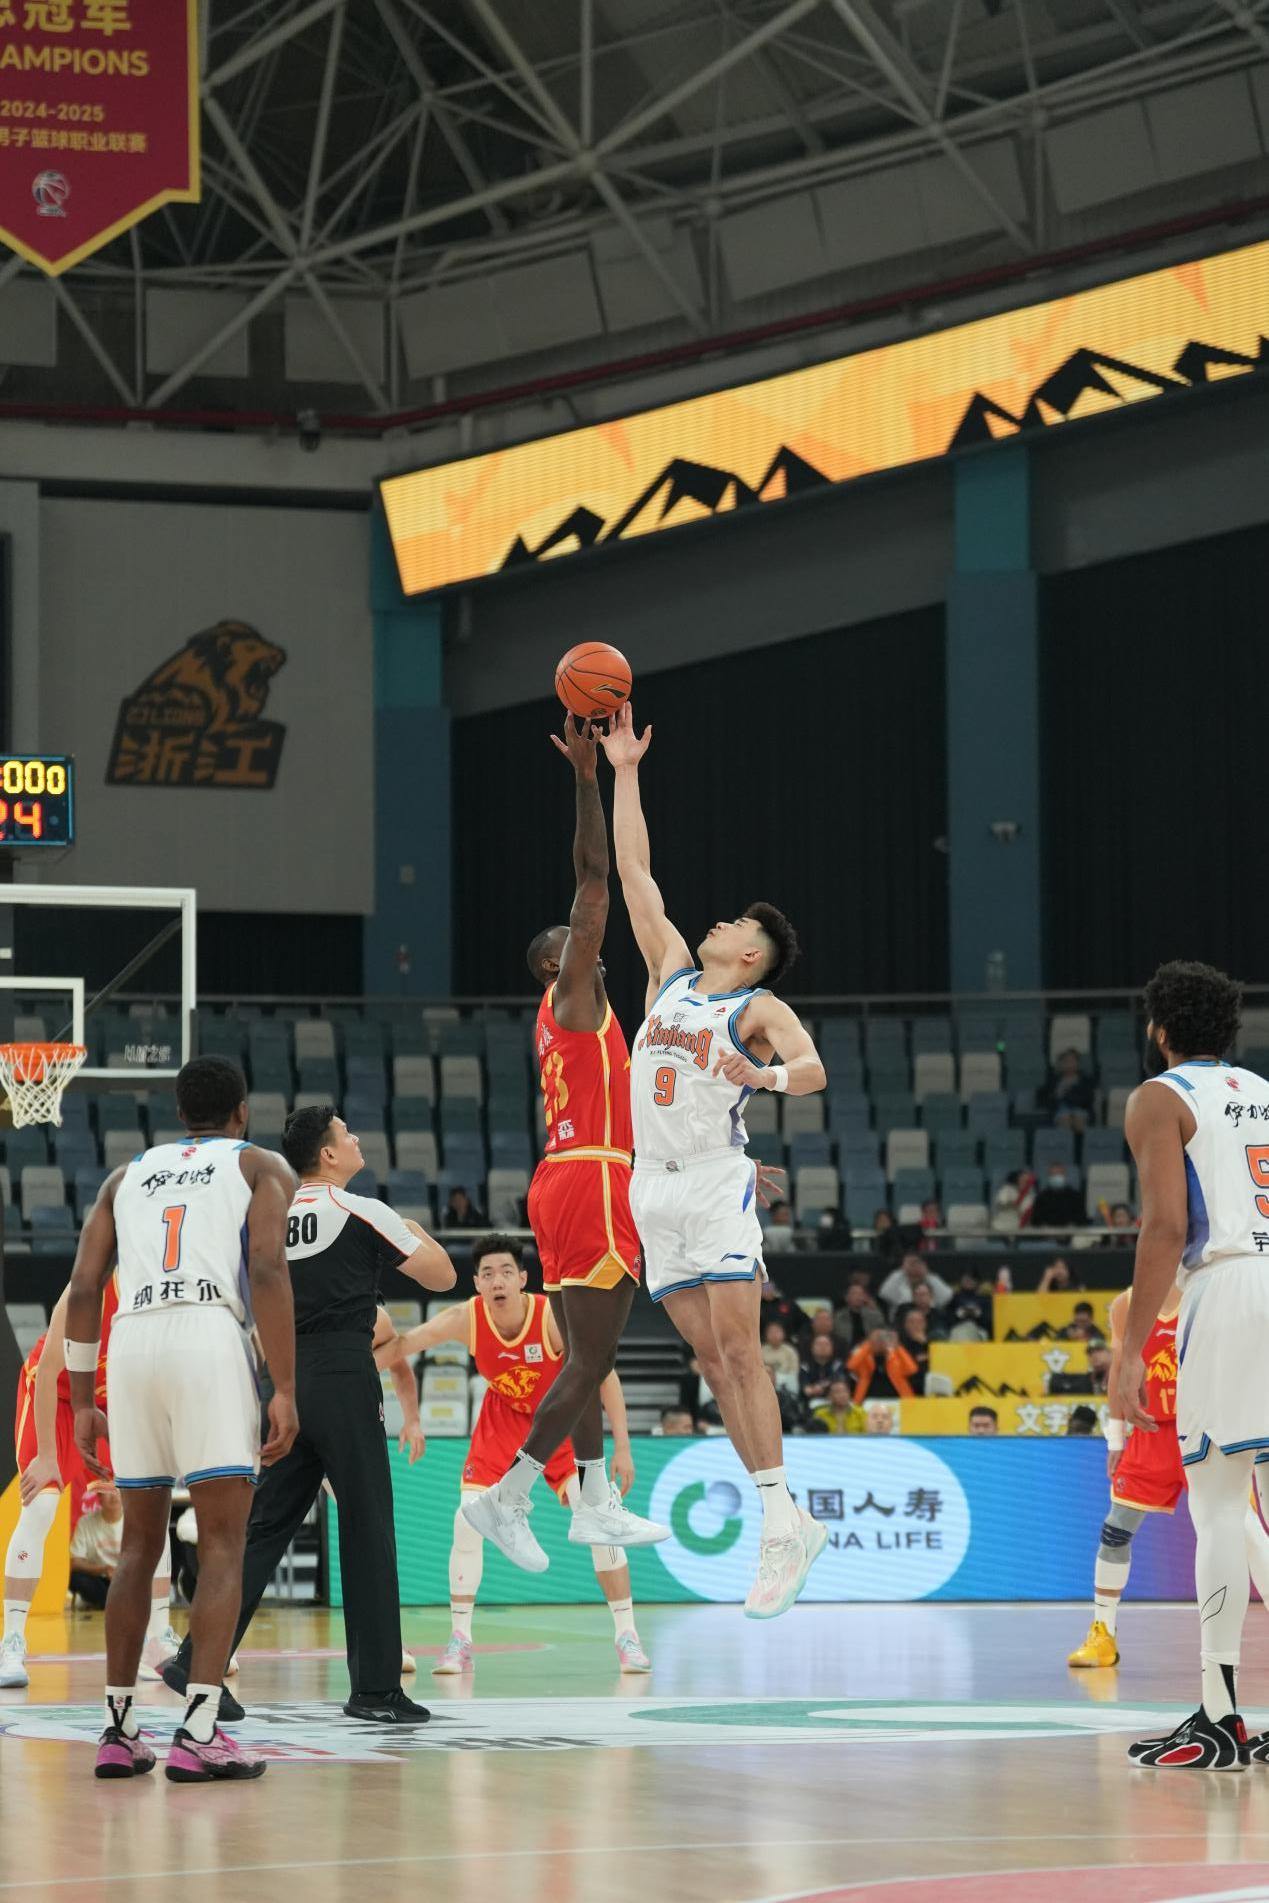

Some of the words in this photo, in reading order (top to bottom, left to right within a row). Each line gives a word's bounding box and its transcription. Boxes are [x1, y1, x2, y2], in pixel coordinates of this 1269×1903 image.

[1, 101, 105, 122] 2024-2025
[654, 1066, 677, 1107] 9
[162, 1204, 187, 1273] 1
[285, 1212, 318, 1248] 80
[790, 1487, 944, 1523] 国人寿
[876, 1530, 943, 1550] LIFE
